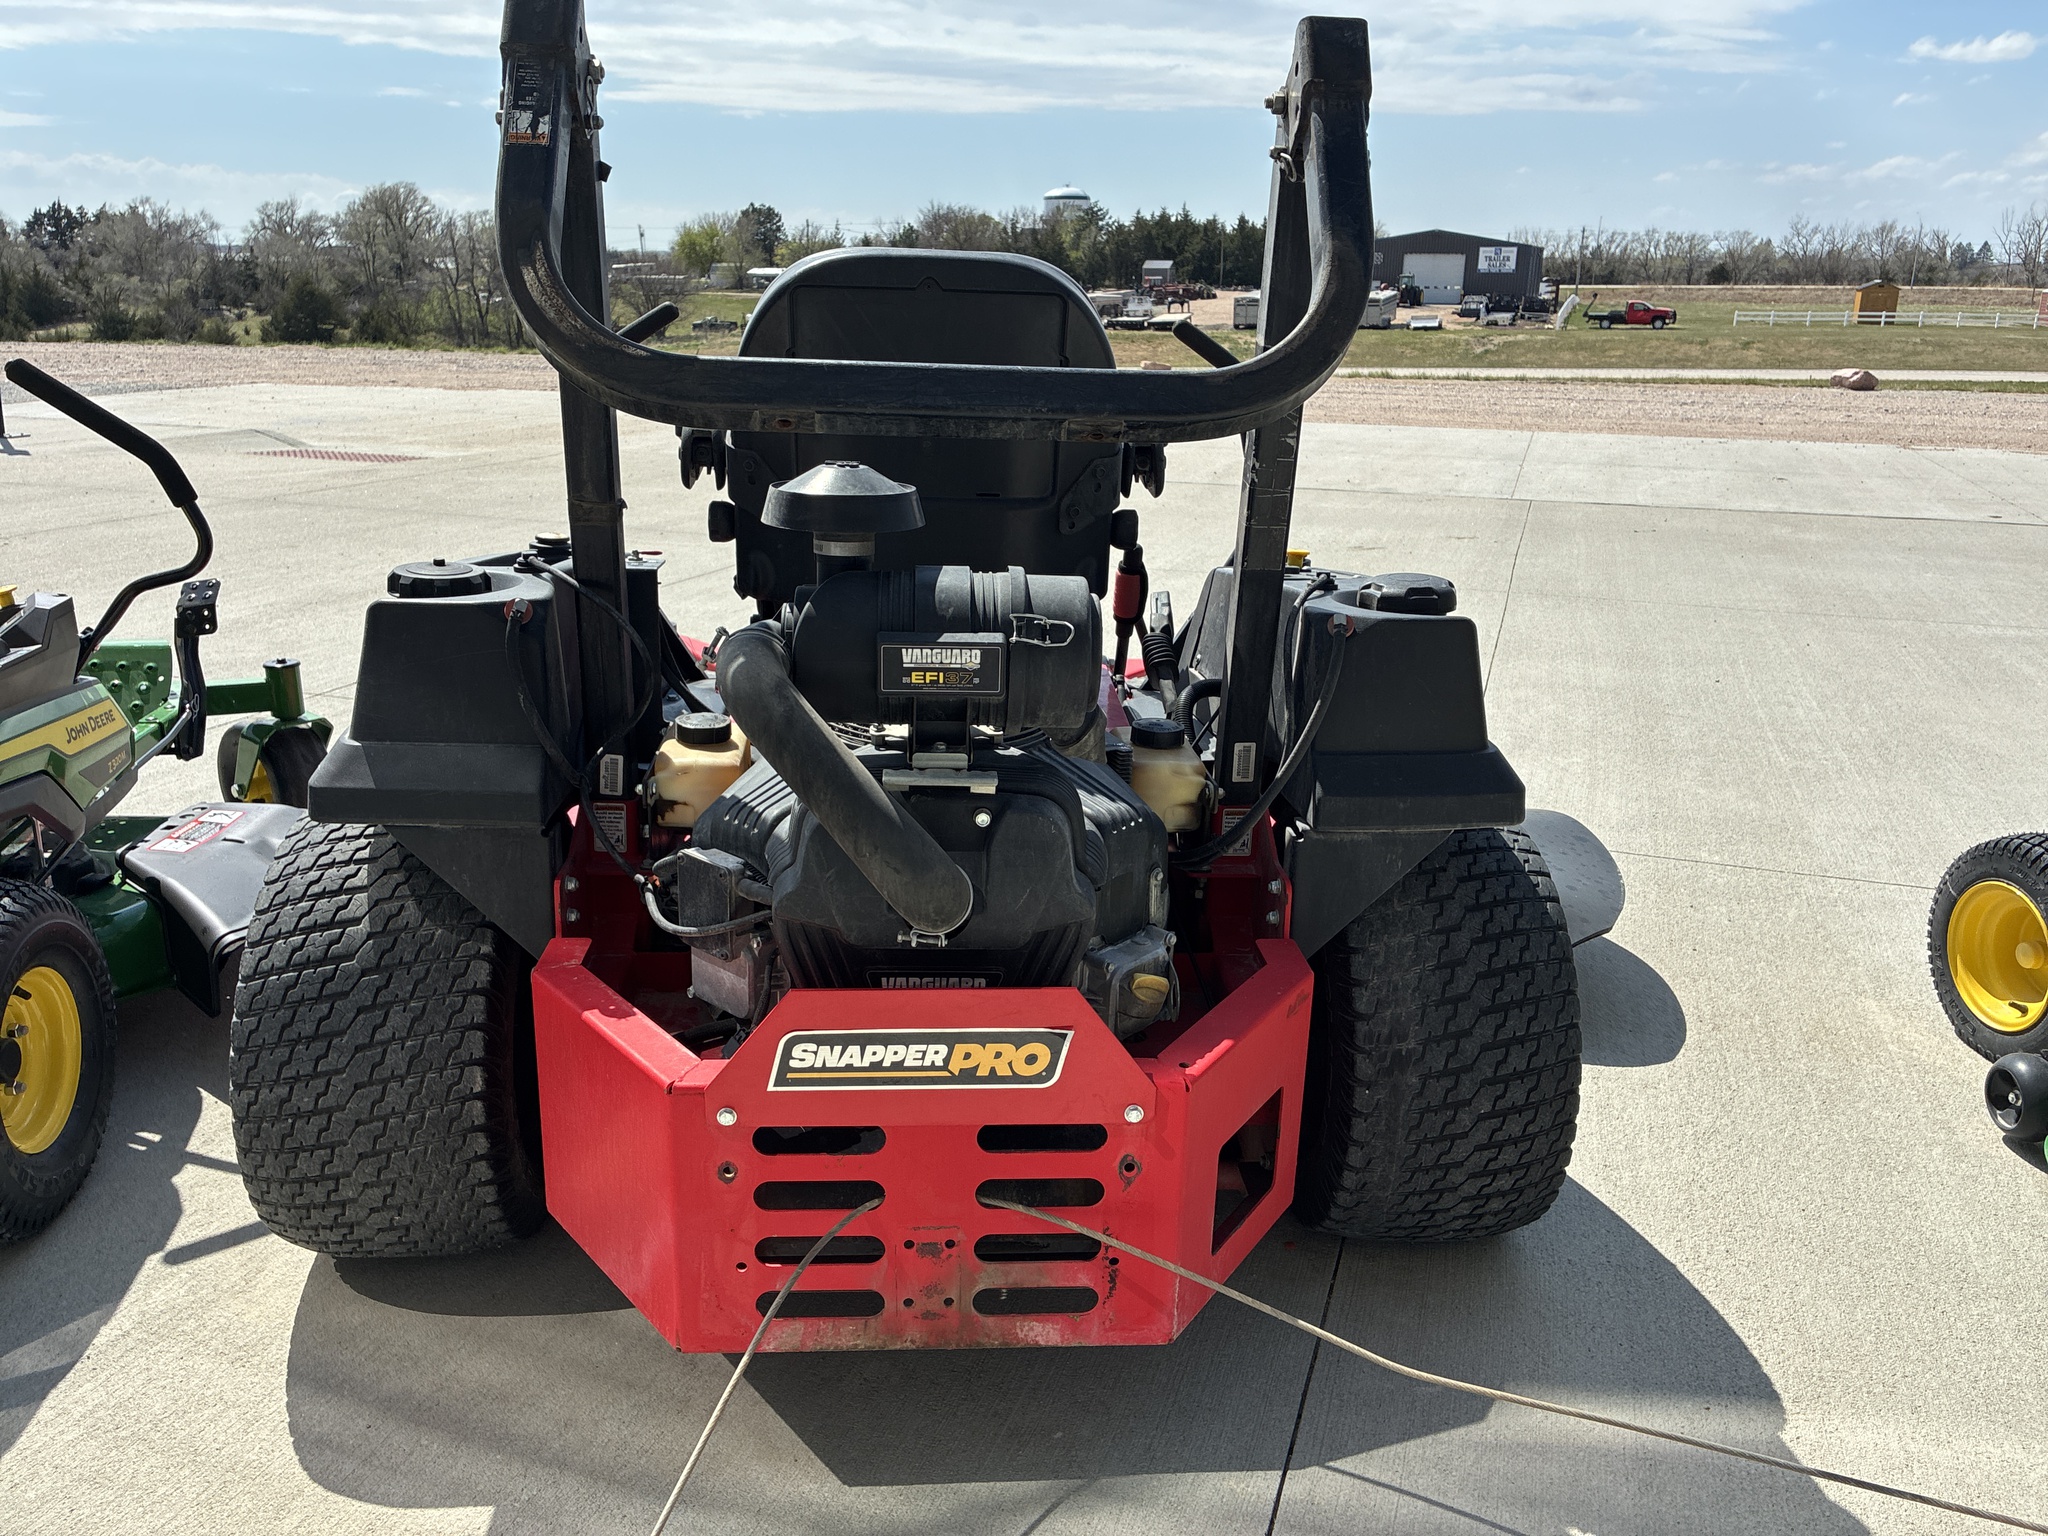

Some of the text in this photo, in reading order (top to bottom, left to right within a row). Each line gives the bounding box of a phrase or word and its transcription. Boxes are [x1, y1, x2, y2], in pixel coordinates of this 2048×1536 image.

[901, 648, 981, 664] VANGUARD
[911, 671, 944, 685] EFI
[945, 672, 974, 685] 37
[65, 709, 116, 744] JOHN DEERE
[788, 1042, 1052, 1076] SNAPPER PRO
